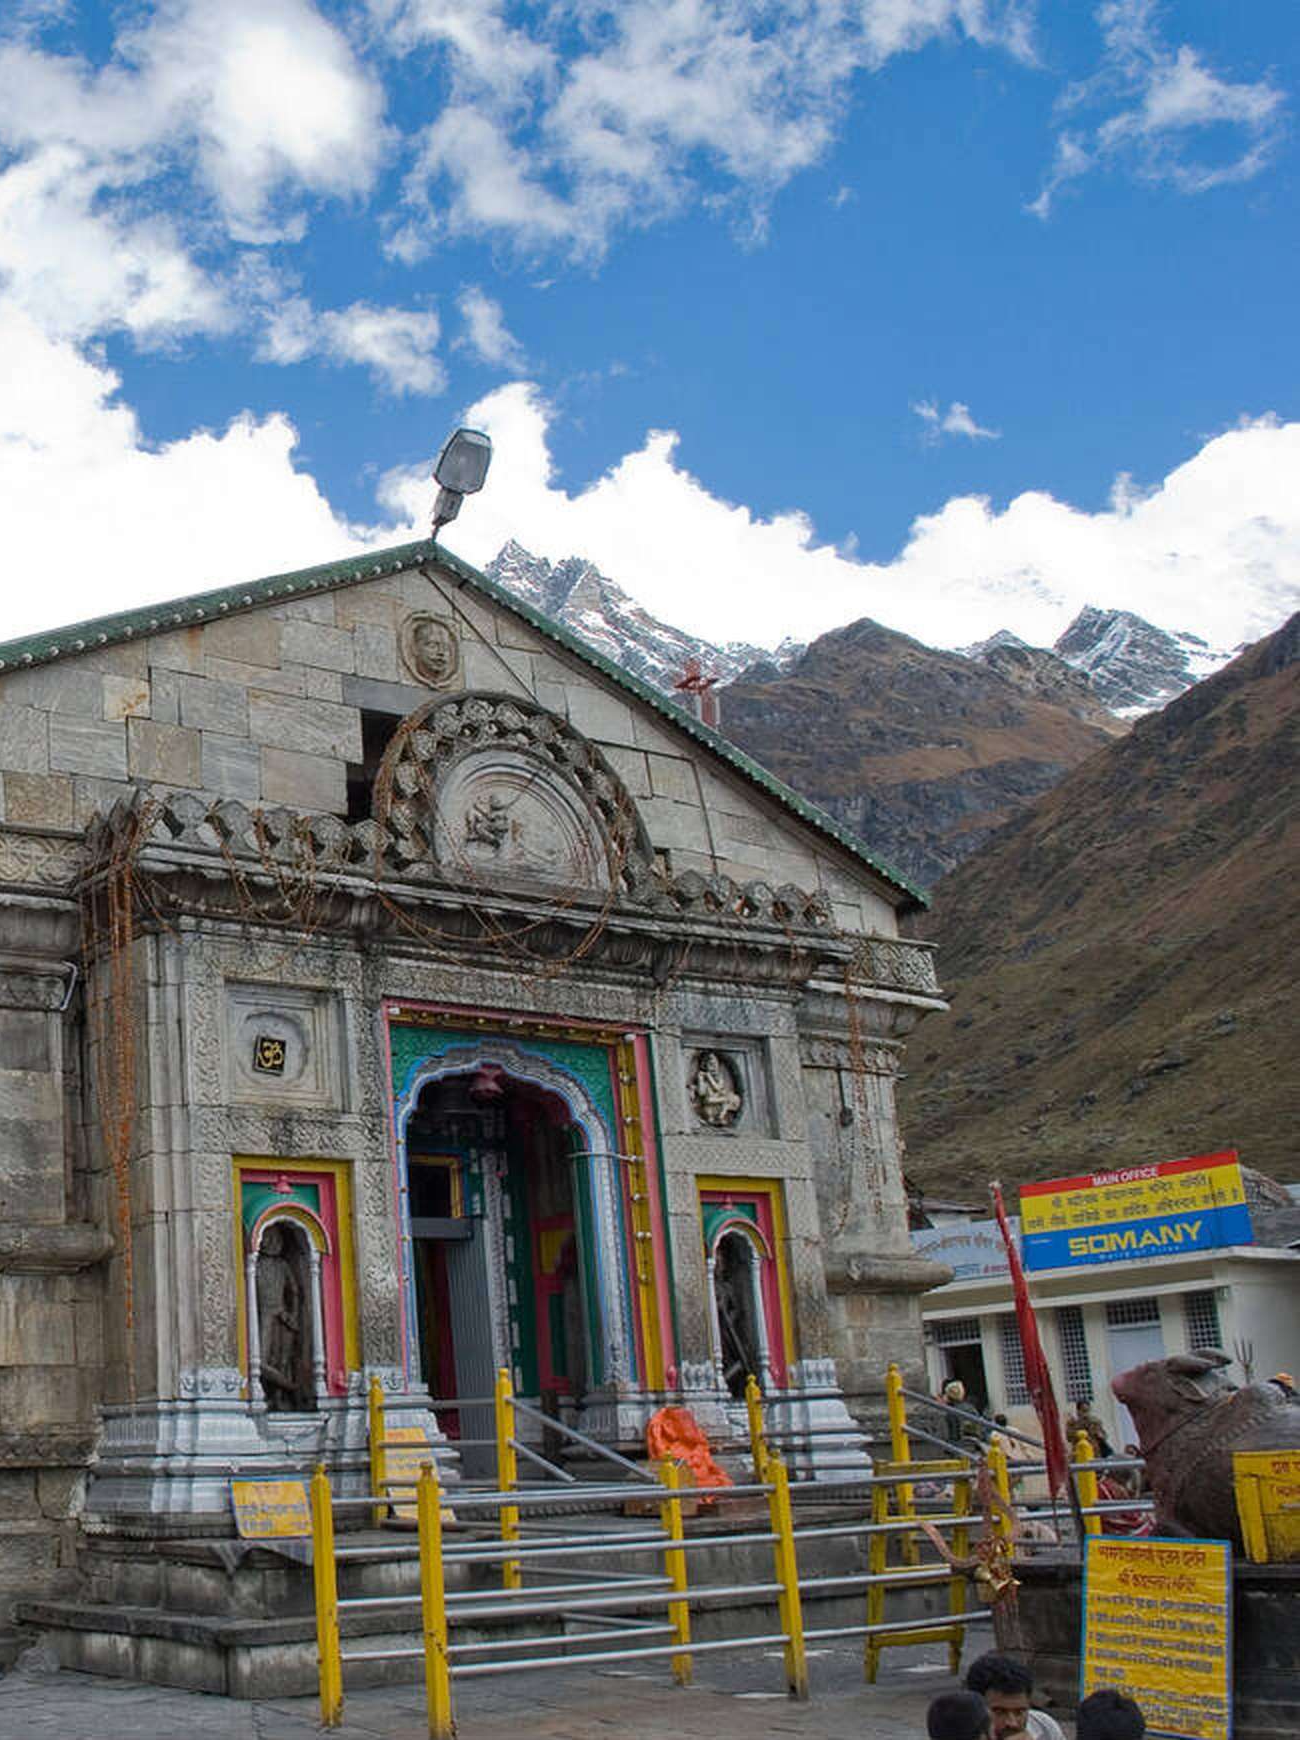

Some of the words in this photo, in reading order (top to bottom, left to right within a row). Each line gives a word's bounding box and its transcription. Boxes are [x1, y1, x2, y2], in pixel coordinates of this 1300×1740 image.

[1092, 1171, 1120, 1187] MAIN
[1120, 1166, 1158, 1183] OFFICE
[1068, 1220, 1202, 1257] SOMANY
